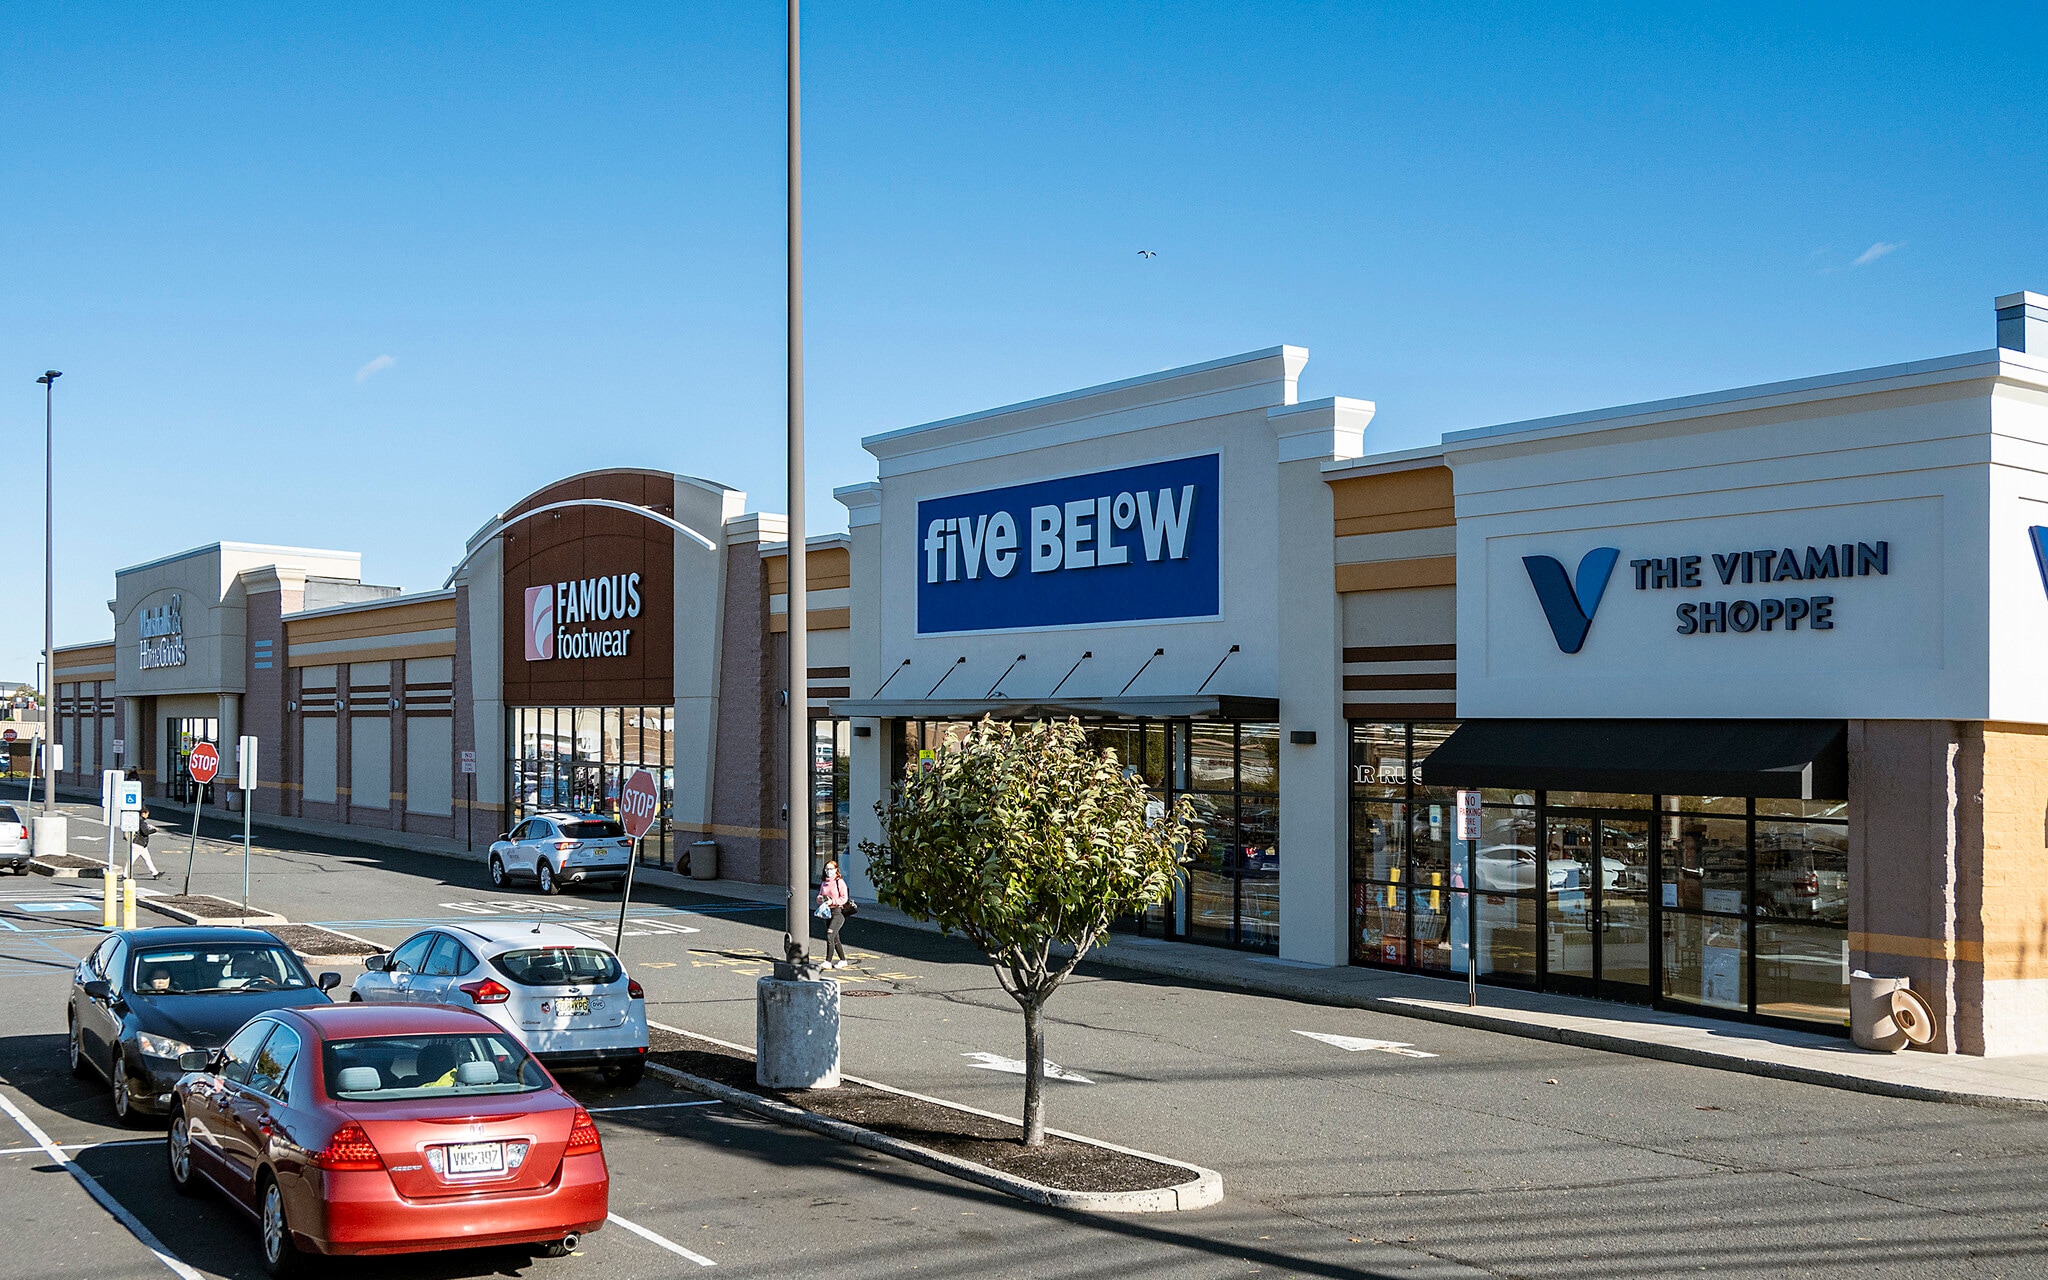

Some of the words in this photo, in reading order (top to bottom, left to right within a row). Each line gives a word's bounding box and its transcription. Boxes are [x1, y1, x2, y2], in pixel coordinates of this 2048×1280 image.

[924, 510, 1018, 583] five
[1630, 555, 1702, 590] THE
[1712, 540, 1888, 585] VITAMIN
[557, 573, 641, 624] FAMOUS
[1676, 596, 1834, 635] SHOPPE
[557, 626, 631, 660] footwear
[191, 753, 217, 771] STOP
[623, 788, 655, 818] STOP
[1459, 807, 1482, 817] PARKING
[1464, 796, 1476, 806] NO
[1385, 945, 1396, 956] $2
